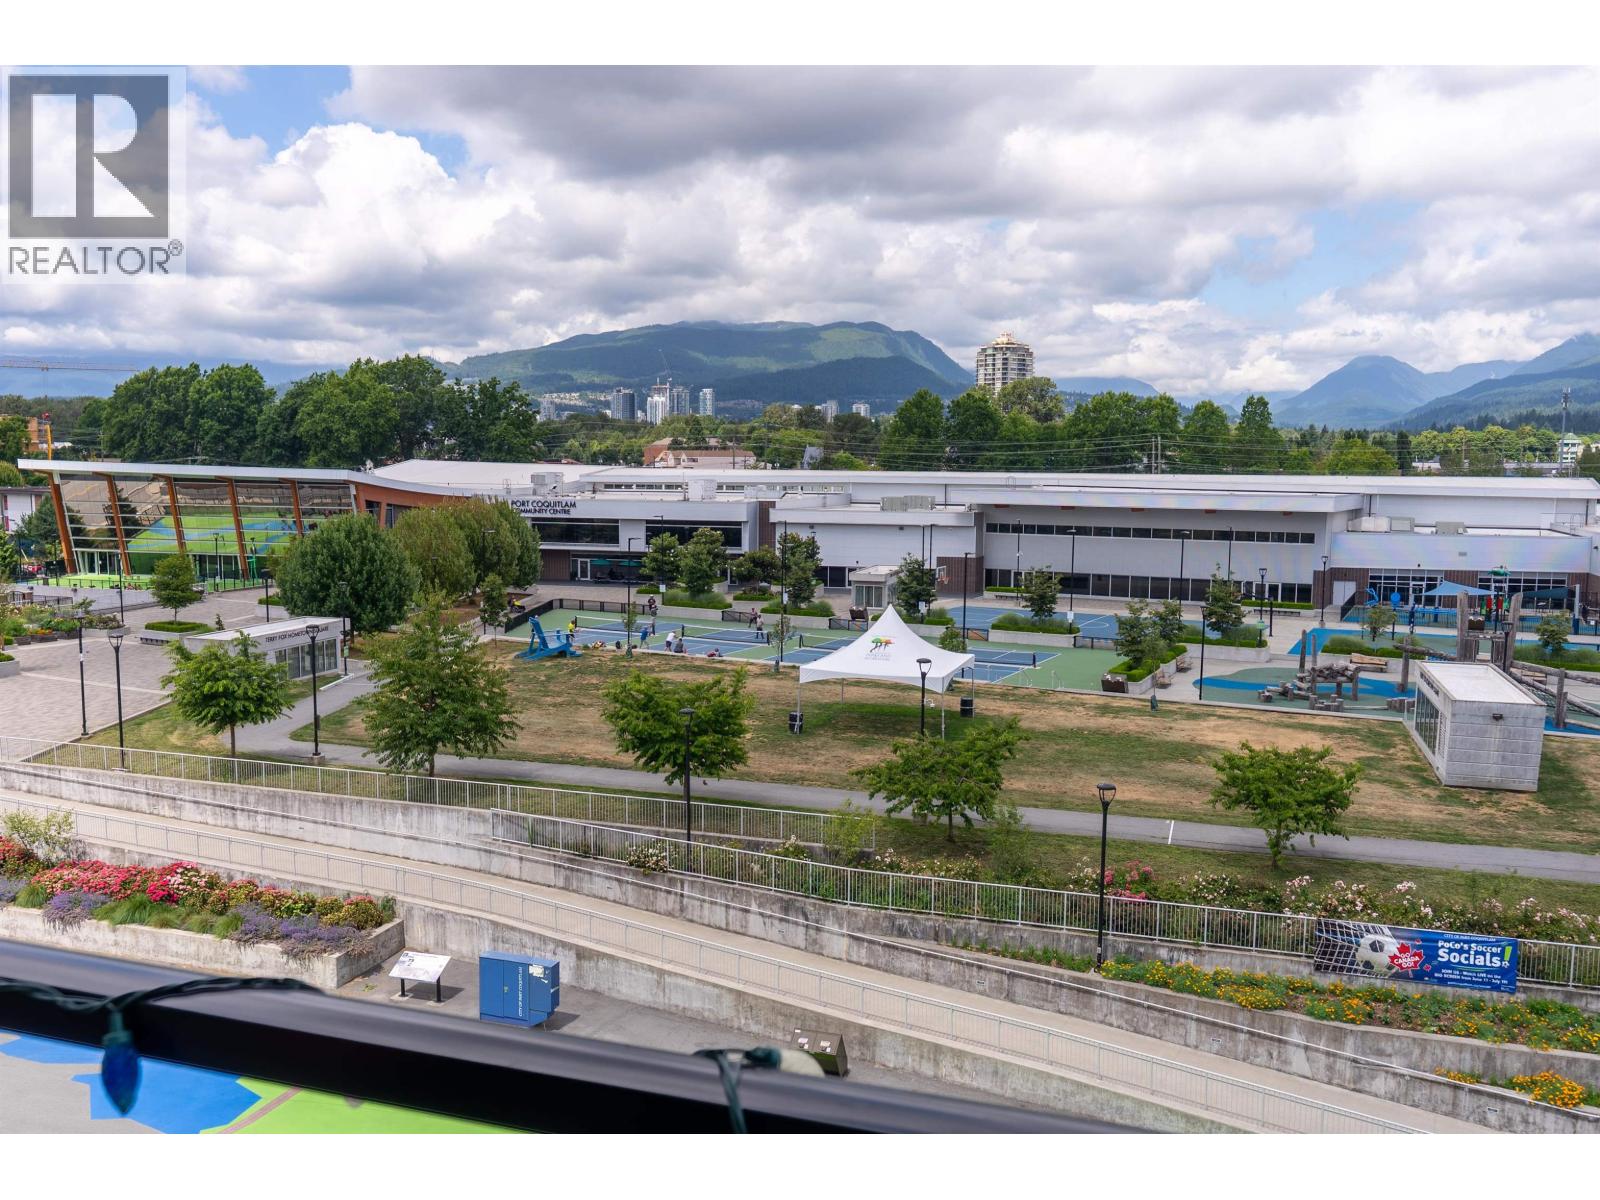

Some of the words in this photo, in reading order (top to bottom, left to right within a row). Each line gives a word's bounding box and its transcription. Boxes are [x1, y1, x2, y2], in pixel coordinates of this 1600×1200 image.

[511, 500, 531, 508] PORT
[531, 500, 577, 509] COQUITLAM
[548, 508, 572, 516] CENTRE
[1438, 940, 1469, 950] PoCo's
[1470, 943, 1502, 953] Soccer
[1394, 956, 1420, 964] CANADA
